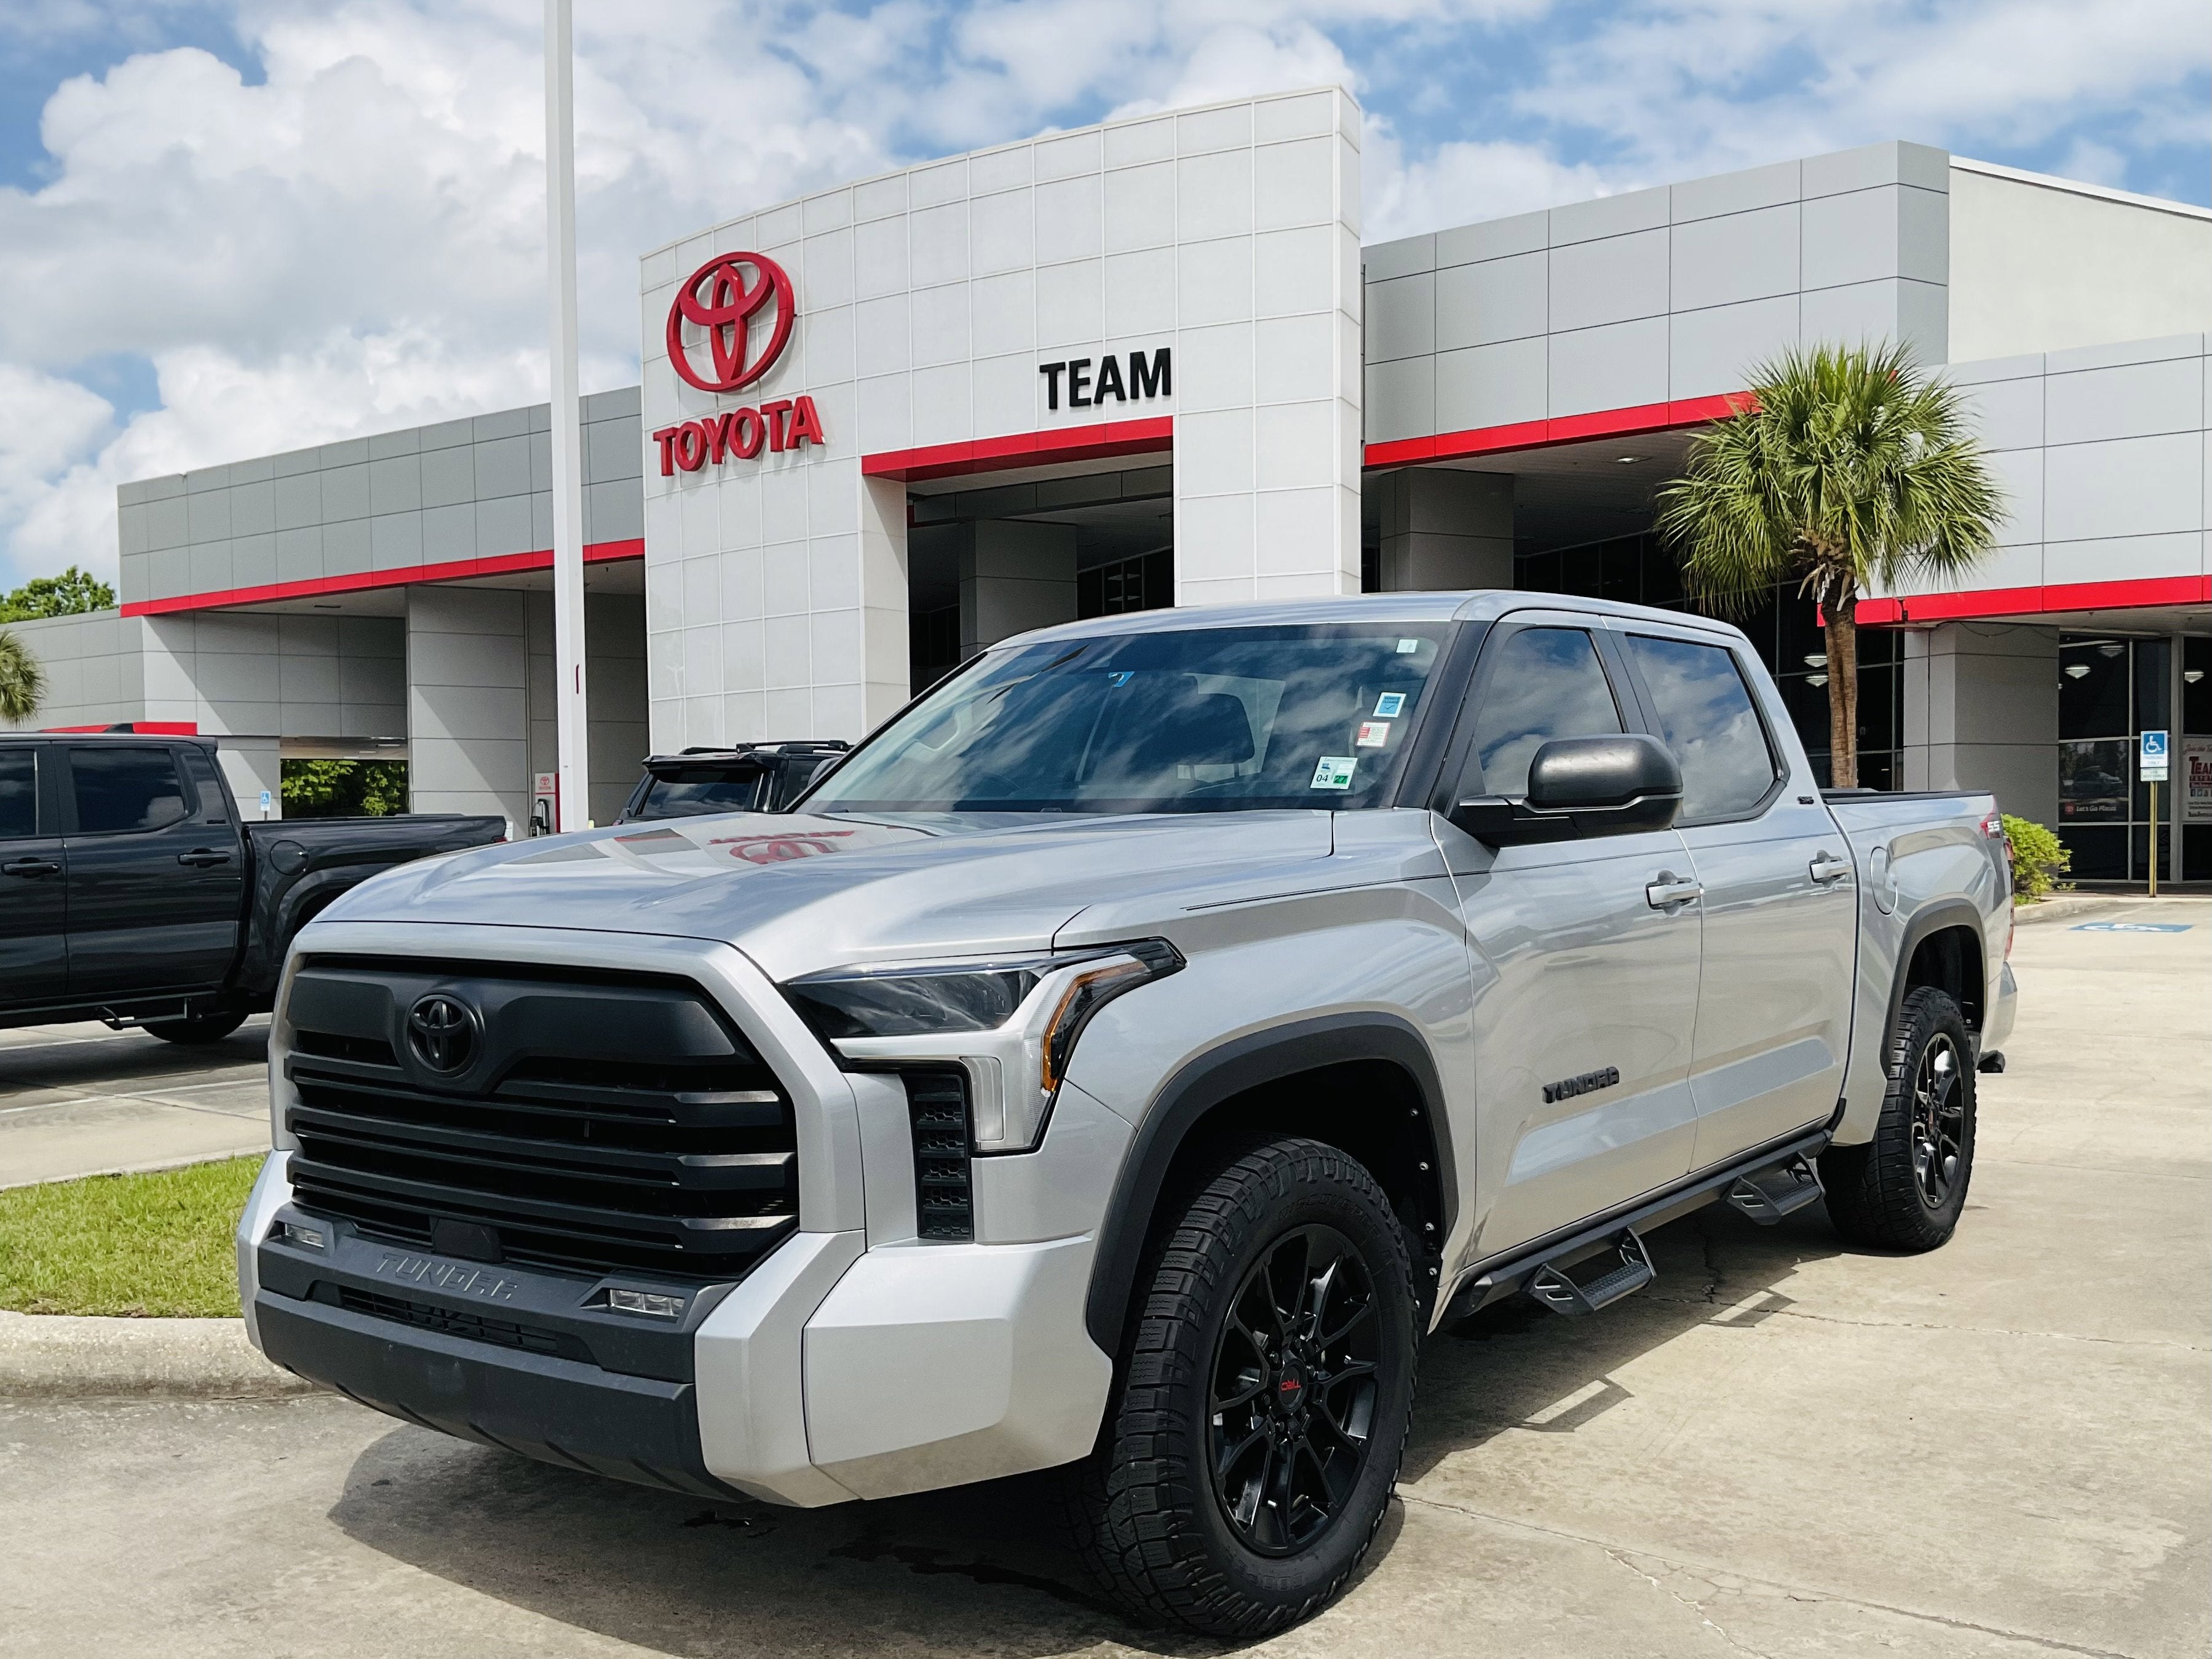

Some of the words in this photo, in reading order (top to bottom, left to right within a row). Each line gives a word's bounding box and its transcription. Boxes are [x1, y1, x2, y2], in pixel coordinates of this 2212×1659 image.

[1039, 347, 1172, 410] TEAM
[653, 395, 825, 477] TOYOTA
[1542, 1066, 1620, 1103] TUNDRA
[376, 1253, 518, 1300] TUNDRA
